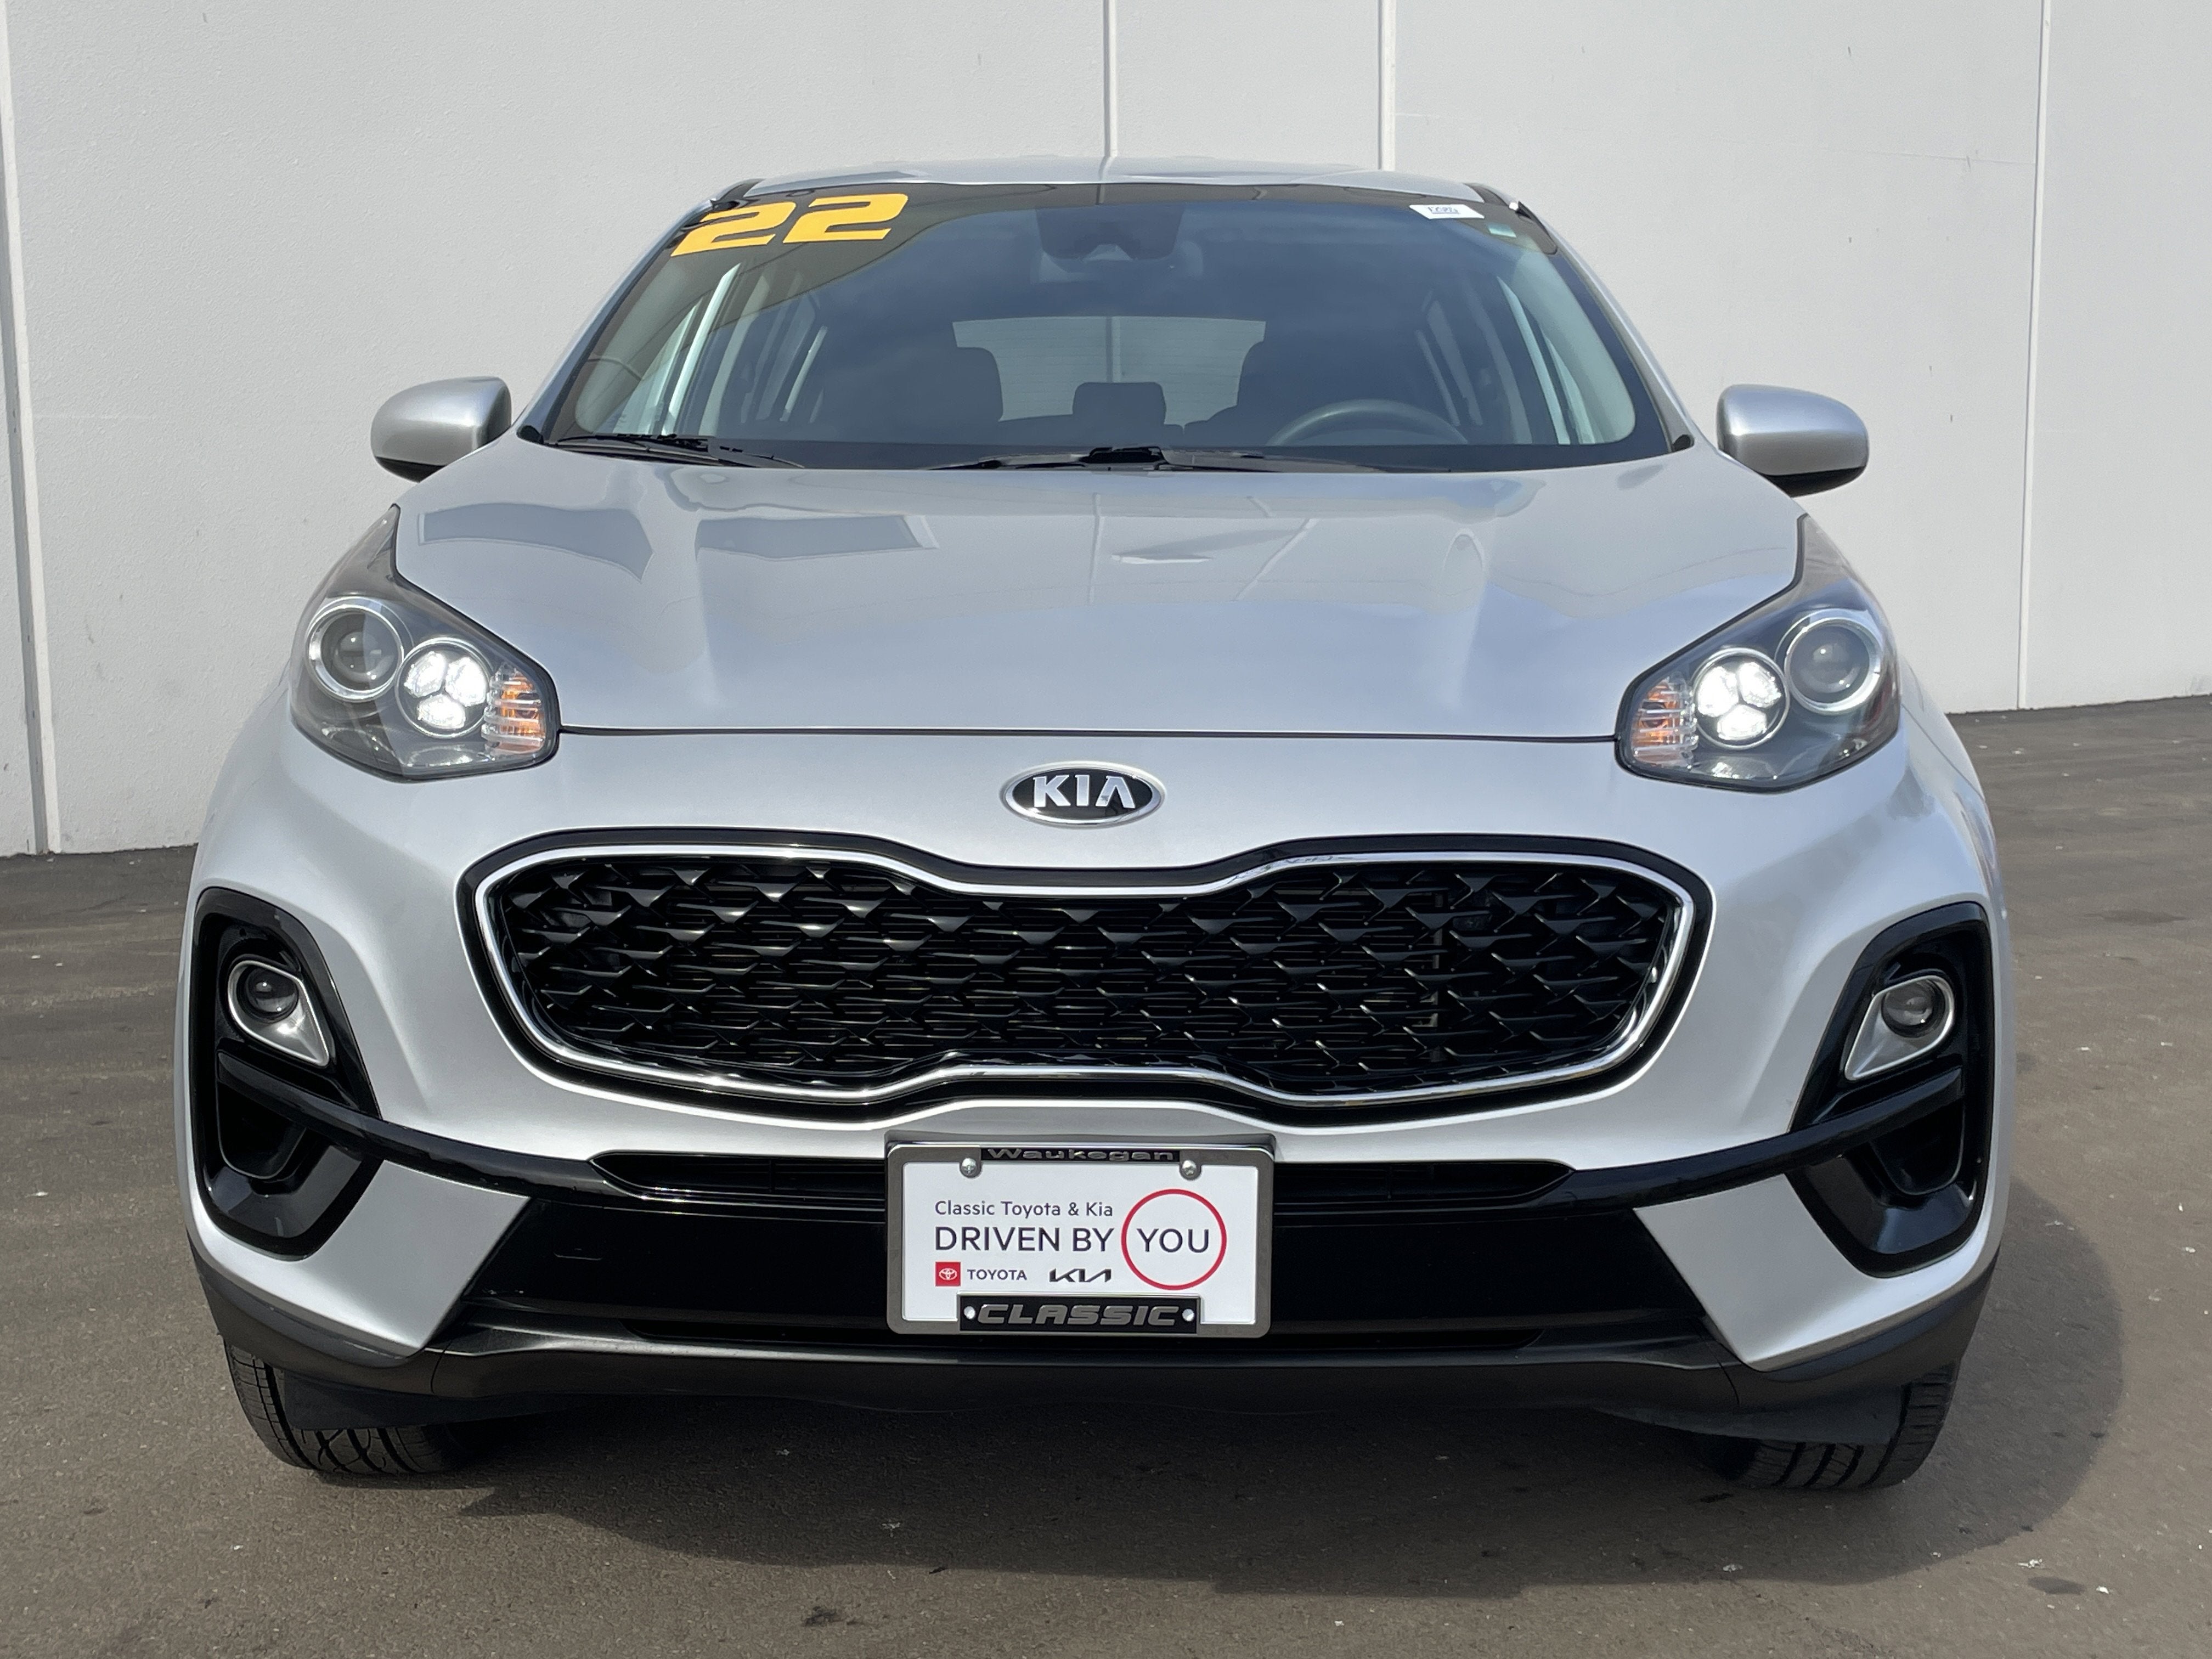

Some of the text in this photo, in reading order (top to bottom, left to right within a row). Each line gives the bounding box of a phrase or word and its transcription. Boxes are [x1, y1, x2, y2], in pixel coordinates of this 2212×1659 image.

[670, 193, 908, 256] 22
[1032, 774, 1135, 808] KIA
[988, 1148, 1173, 1161] Waukegan
[935, 1200, 1113, 1218] Classic Toyota & Kia
[935, 1227, 1209, 1253] DRIVEN BY YOU
[967, 1269, 1027, 1280] TOYOTA
[978, 1304, 1180, 1326] CLASSIC
